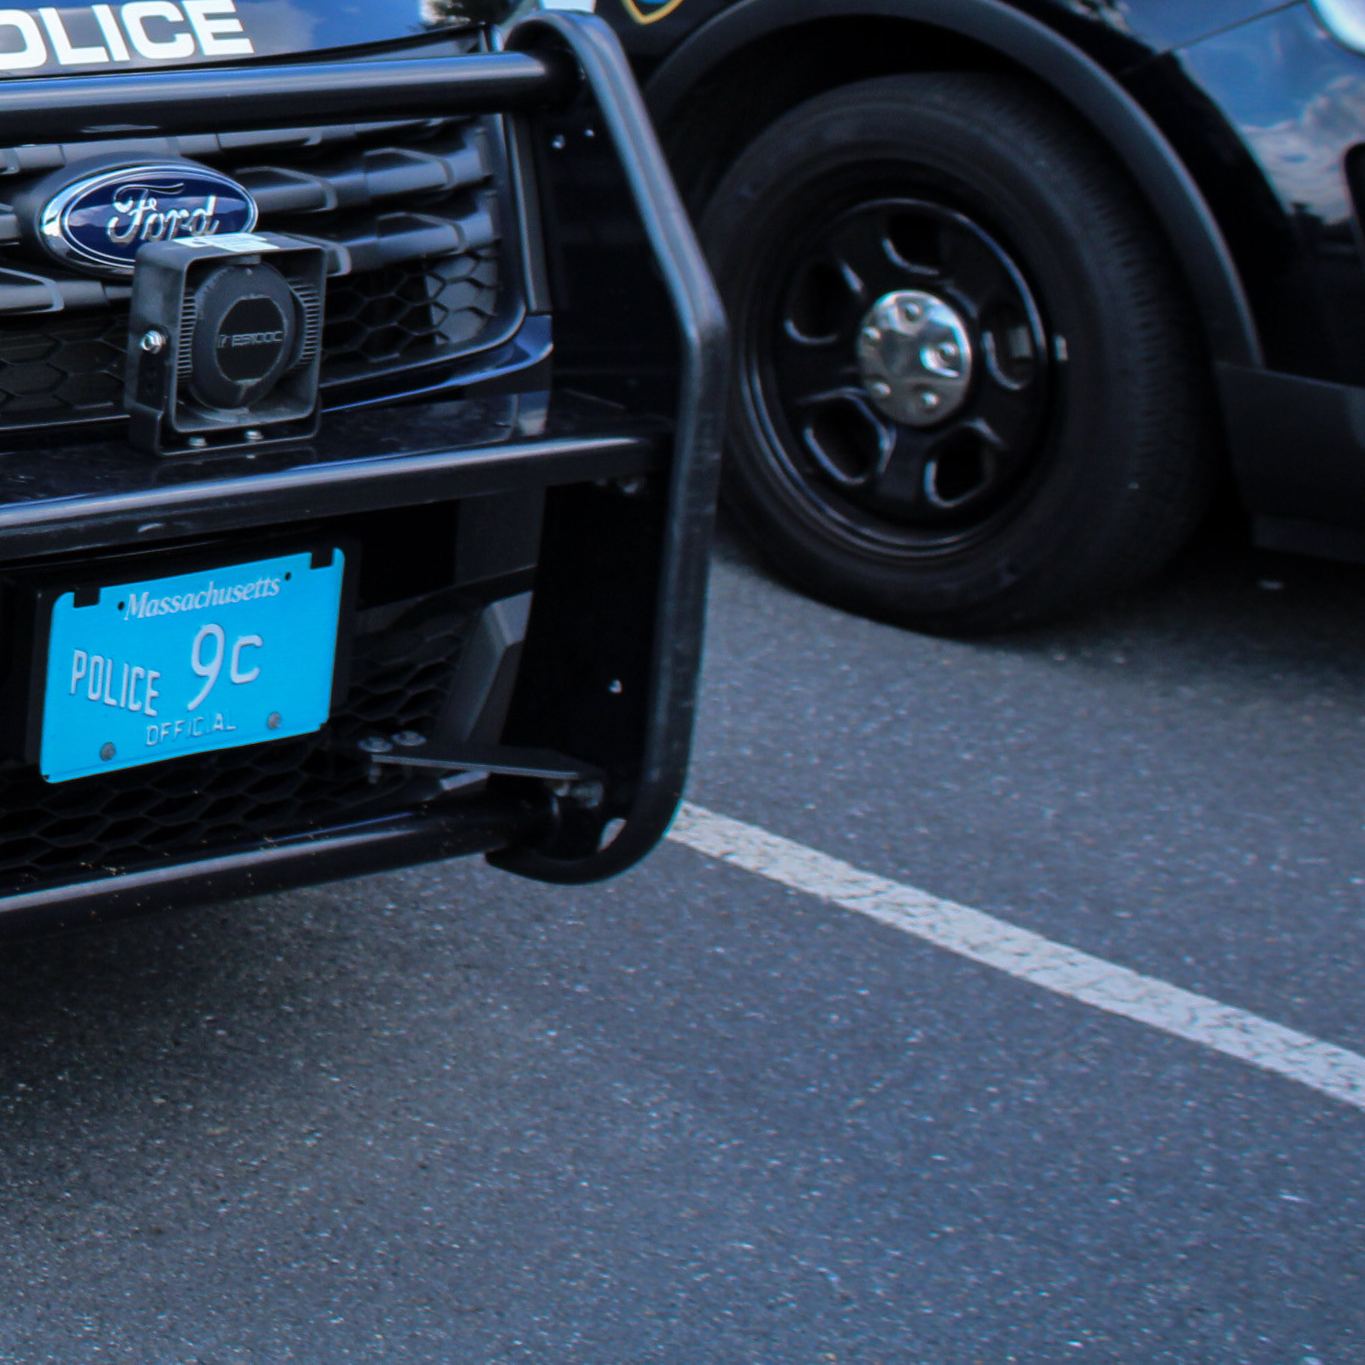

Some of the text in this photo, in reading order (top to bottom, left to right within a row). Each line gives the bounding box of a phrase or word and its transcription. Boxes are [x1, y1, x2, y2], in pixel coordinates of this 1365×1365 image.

[107, 182, 220, 244] Ford
[123, 577, 282, 621] Massachusetts
[69, 649, 161, 718] POLICE
[145, 713, 237, 748] OFFICIAL
